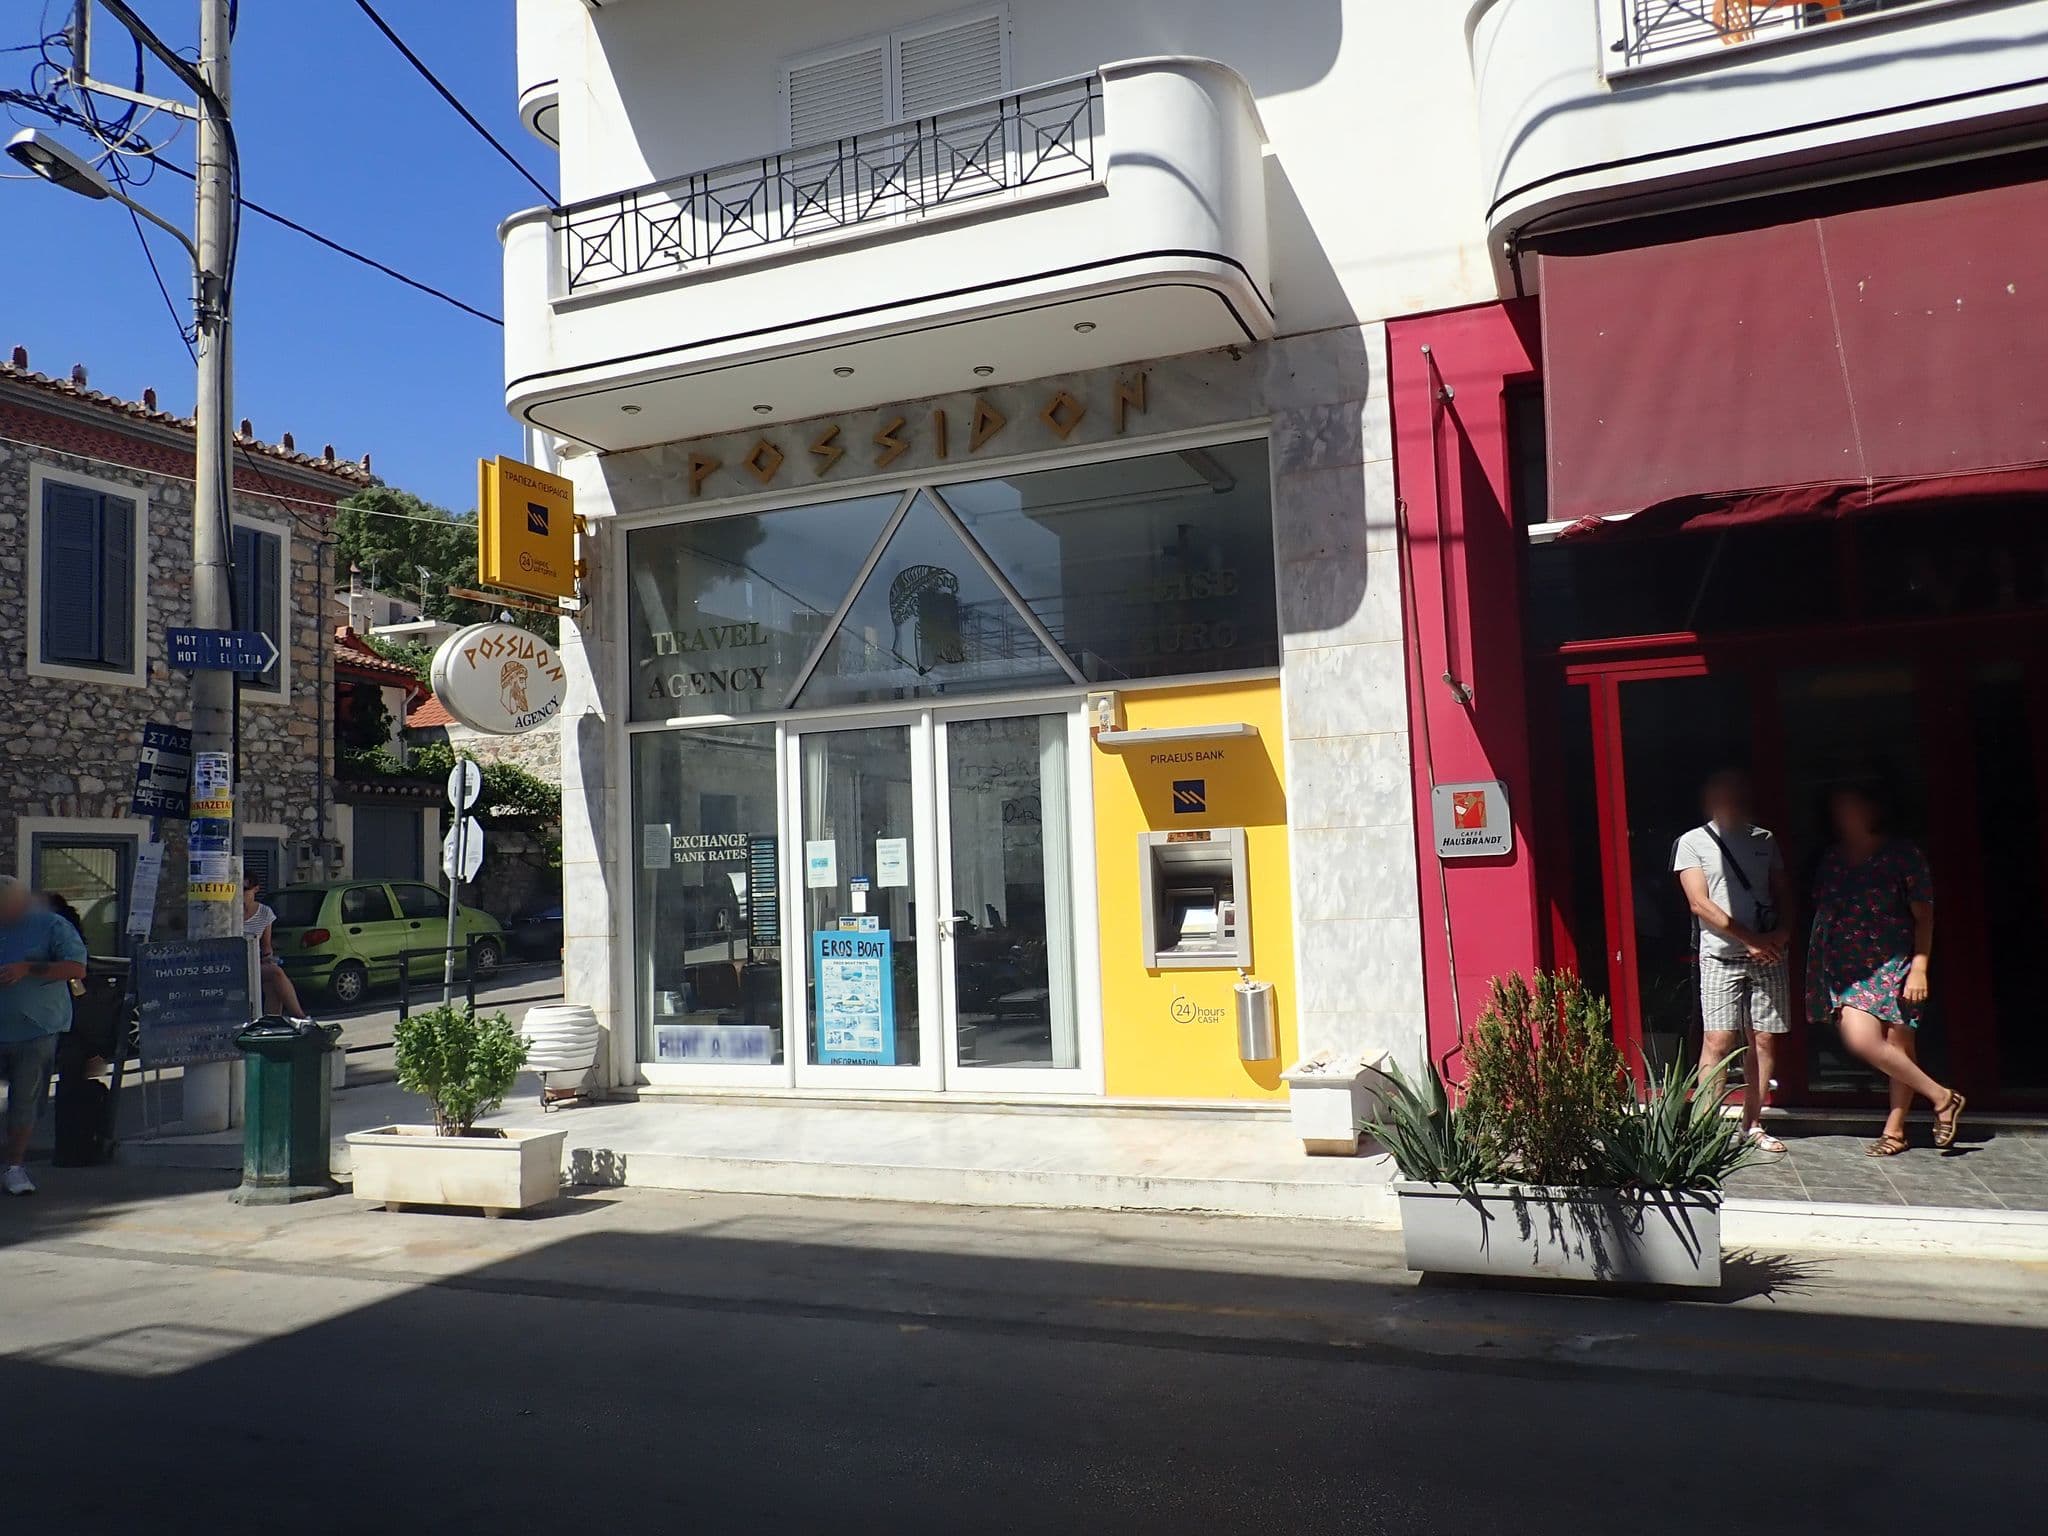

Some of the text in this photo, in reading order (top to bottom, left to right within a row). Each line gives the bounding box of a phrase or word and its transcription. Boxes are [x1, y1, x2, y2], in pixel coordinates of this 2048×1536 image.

[689, 372, 1149, 496] POSSIDON
[505, 470, 537, 488] ΤΡΑΠΕΖΑ
[652, 622, 768, 655] TRAVEL
[464, 634, 563, 682] POSSIDON
[648, 666, 768, 699] AGENCY
[515, 696, 560, 728] AGENCY
[1150, 750, 1224, 764] PIRAEUS BANK
[672, 833, 748, 849] EXCHANGE
[1442, 836, 1502, 847] HAUSBRANDT
[674, 848, 748, 862] BANK RATES
[822, 940, 885, 957] EROS BOAT
[1176, 1004, 1225, 1017] 24 hours
[1197, 1016, 1219, 1024] CASH
